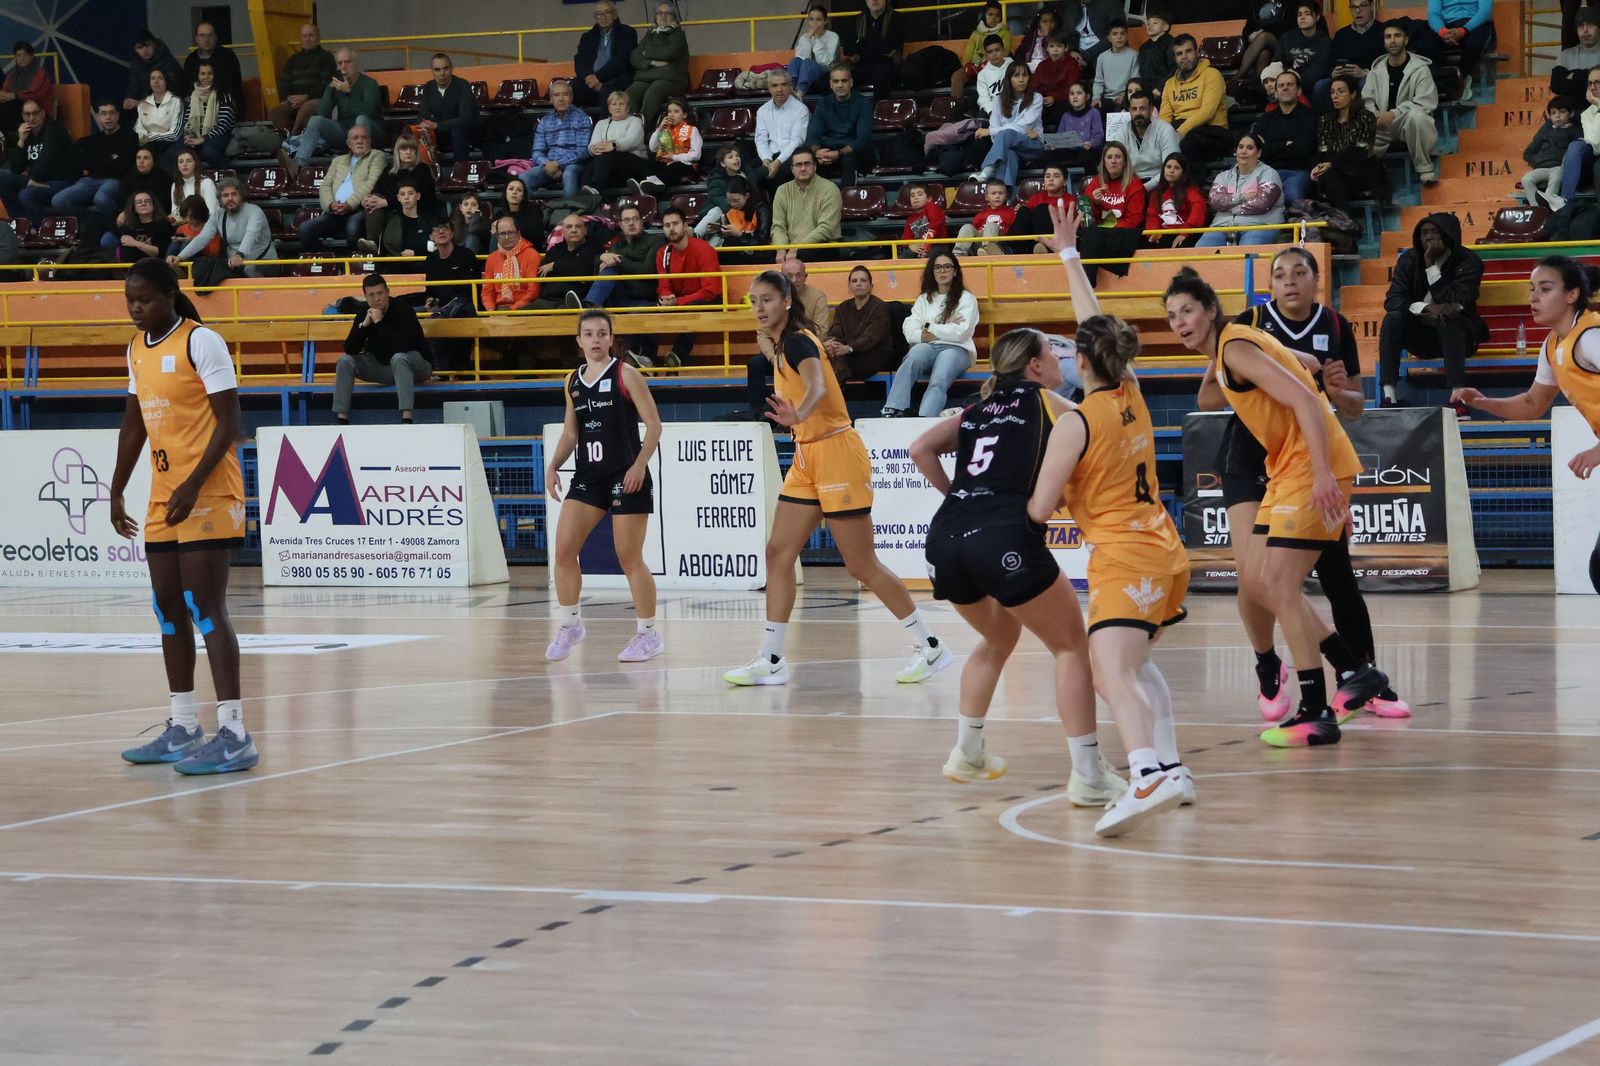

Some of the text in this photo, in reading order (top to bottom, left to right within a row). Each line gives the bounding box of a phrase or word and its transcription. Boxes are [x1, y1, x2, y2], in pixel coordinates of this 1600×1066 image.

[1216, 40, 1229, 50] 17
[718, 71, 727, 81] 2
[513, 83, 524, 92] 10
[893, 103, 901, 114] 7
[730, 110, 736, 121] 1
[314, 170, 324, 179] 14
[469, 163, 477, 174] 8
[1465, 159, 1513, 178] FILA
[859, 189, 868, 200] 9
[688, 197, 697, 208] 5
[1515, 210, 1534, 223] 27
[586, 440, 603, 463] 10
[678, 439, 754, 462] LUIS FELIPE
[881, 448, 910, 460] CAMIN
[967, 435, 999, 477] 5
[152, 448, 170, 472] 23
[886, 462, 900, 474] 980
[902, 462, 916, 474] 570
[1352, 464, 1431, 486] HÓN
[710, 469, 755, 495] GÓMEZ
[893, 477, 904, 489] del
[906, 478, 922, 489] Vino
[1134, 461, 1155, 505] 4
[696, 506, 757, 528] FERRERO
[1351, 498, 1427, 533] SUEÑA
[873, 524, 906, 535] ERVICIO
[908, 524, 915, 535] A
[269, 536, 303, 546] Avenida
[305, 537, 323, 546] Tres
[325, 536, 355, 546] Cruces
[357, 537, 366, 546] 17
[369, 537, 386, 546] Entr
[400, 536, 426, 546] 49008
[427, 536, 460, 546] Zamora
[1047, 527, 1081, 545] TAR
[1203, 533, 1229, 545] SIN
[107, 539, 147, 562] salu
[873, 540, 926, 551] asóleo de Calefa
[291, 551, 452, 562] marianandresasesoria@gmail.com
[678, 553, 758, 578] ABOGADO
[105, 570, 147, 578] PERSON
[291, 567, 312, 578] 980
[315, 567, 330, 578] 05
[333, 567, 347, 578] 85
[350, 567, 365, 578] 90
[376, 567, 398, 578] 605
[401, 567, 416, 578] 76
[418, 567, 433, 578] 71
[436, 567, 451, 578] 05
[1381, 569, 1429, 577] DESCANSO
